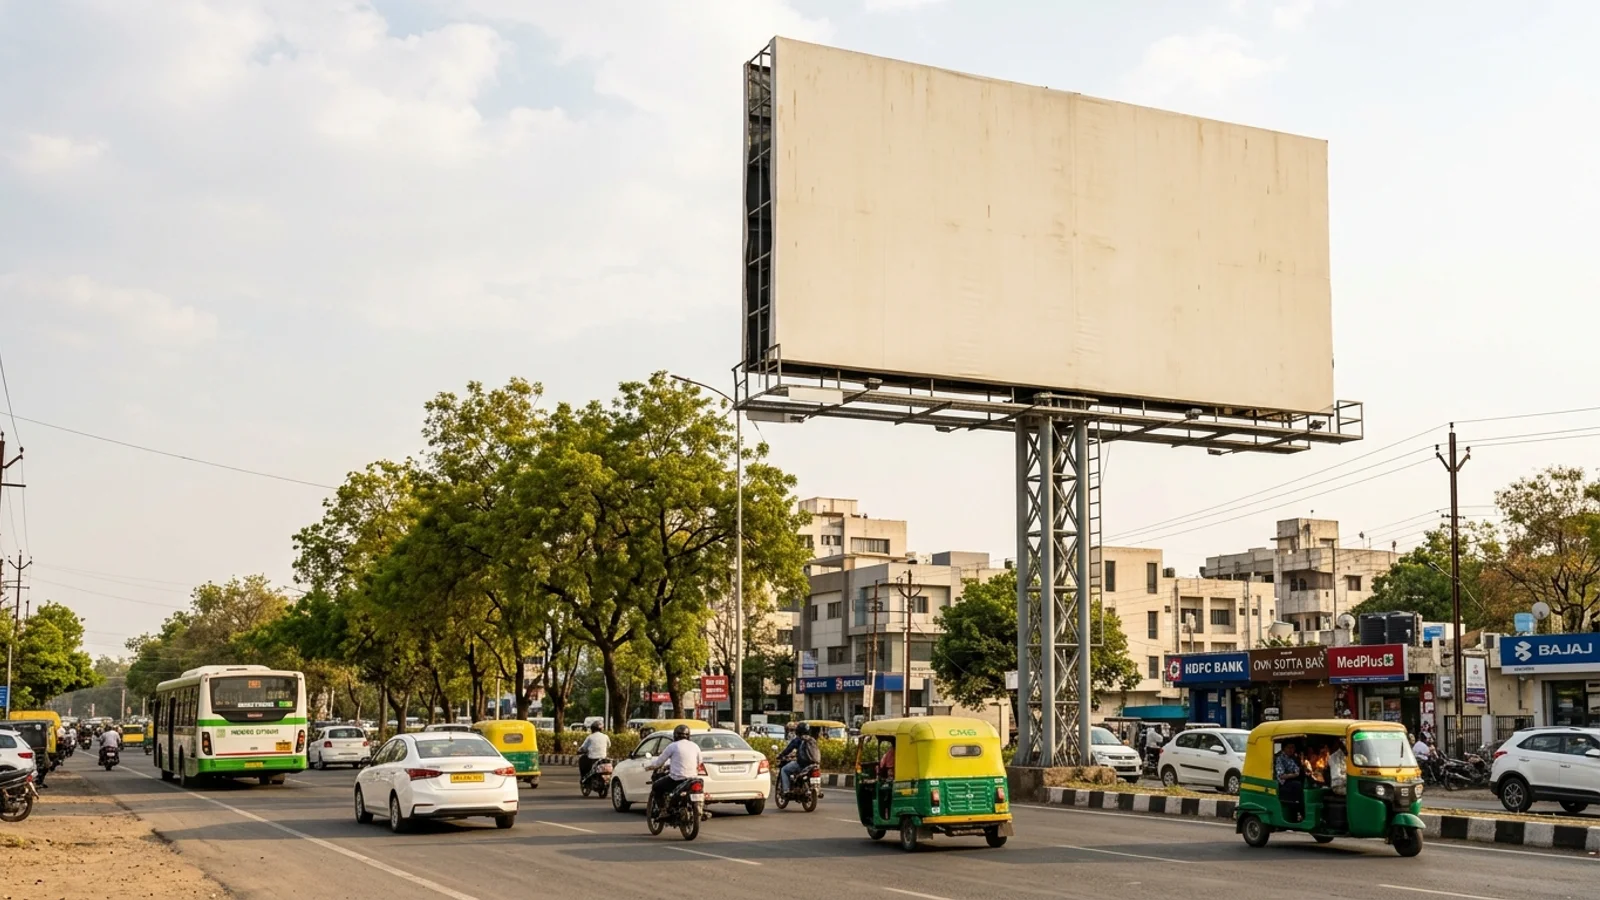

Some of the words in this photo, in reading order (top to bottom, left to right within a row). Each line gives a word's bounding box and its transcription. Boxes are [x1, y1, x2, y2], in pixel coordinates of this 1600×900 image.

[1538, 643, 1593, 656] BAJAJ
[1214, 660, 1244, 673] BANK
[1273, 658, 1303, 670] SOTTA
[1336, 654, 1383, 669] MedPlus
